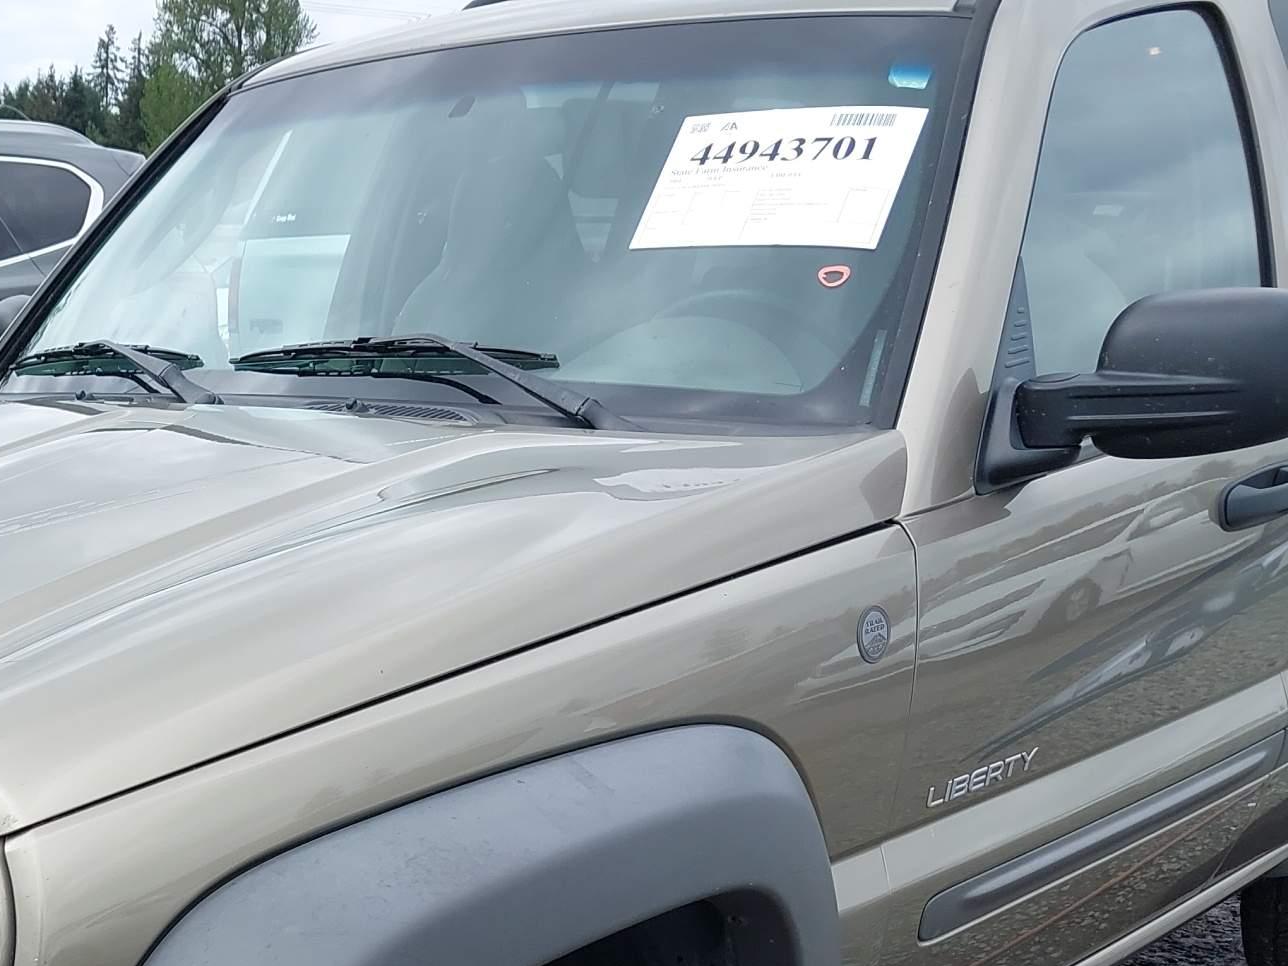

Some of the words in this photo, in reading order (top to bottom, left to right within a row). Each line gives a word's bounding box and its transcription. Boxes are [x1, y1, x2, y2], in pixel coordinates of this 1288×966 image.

[689, 135, 879, 166] 44943701
[671, 168, 695, 177] State
[722, 164, 769, 174] Insurance
[925, 746, 1040, 808] LIBERTY
